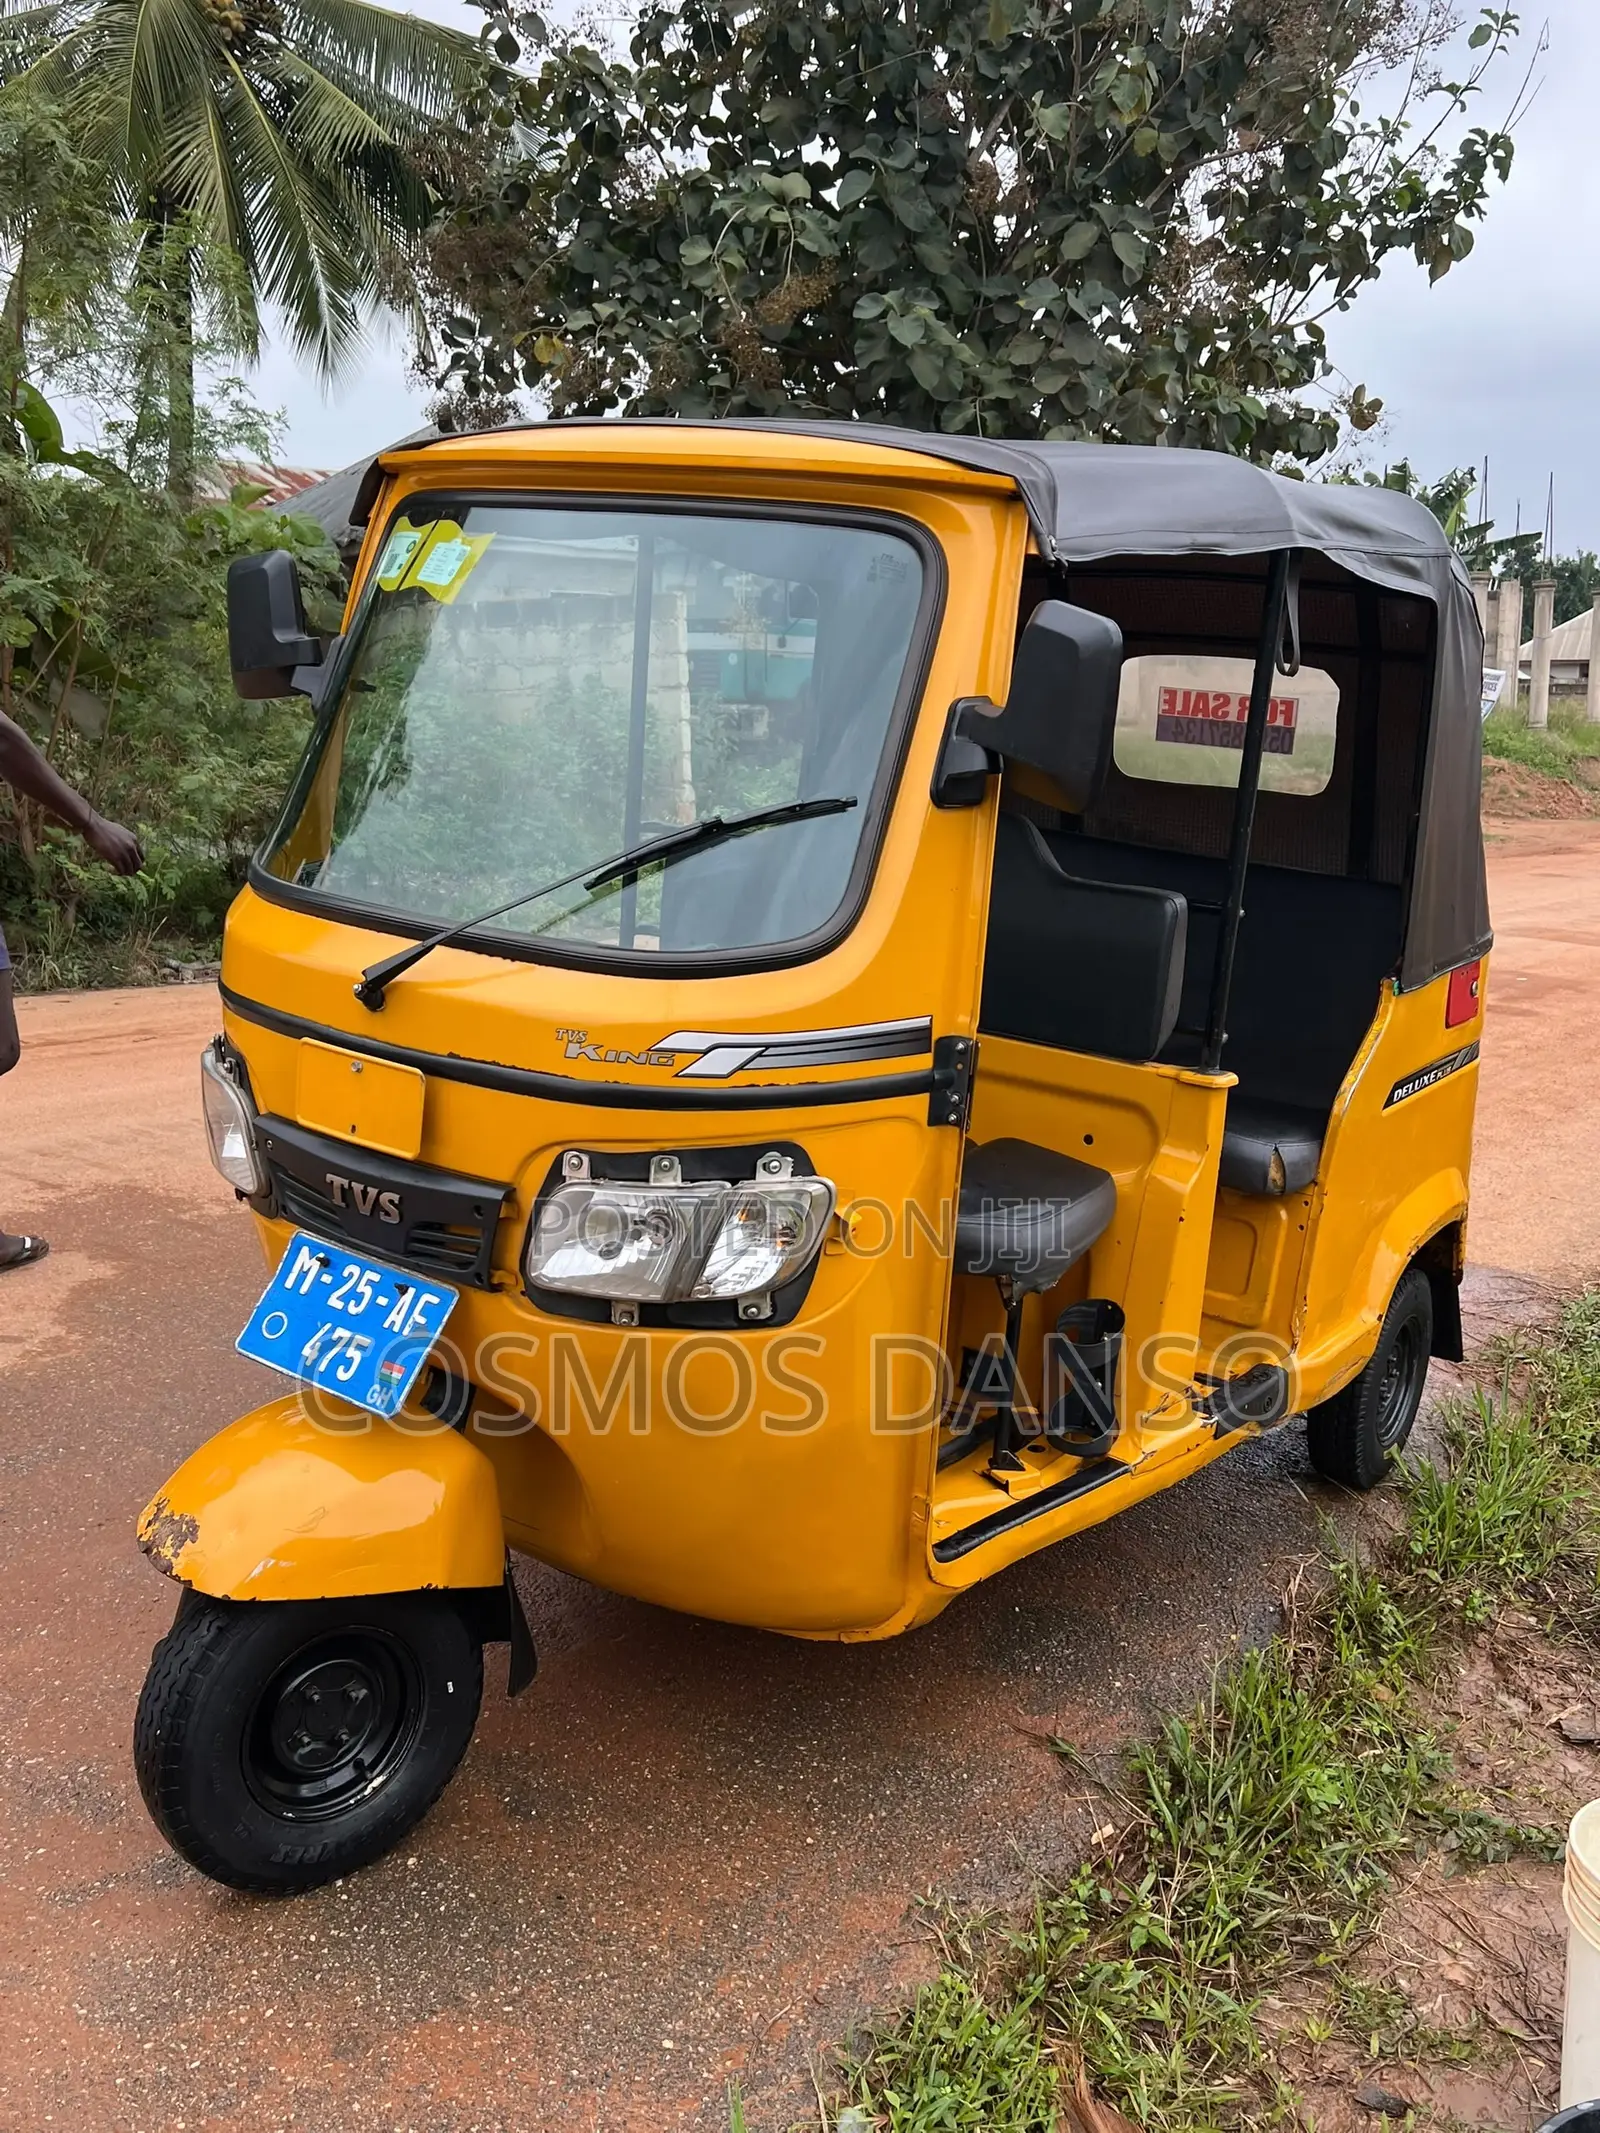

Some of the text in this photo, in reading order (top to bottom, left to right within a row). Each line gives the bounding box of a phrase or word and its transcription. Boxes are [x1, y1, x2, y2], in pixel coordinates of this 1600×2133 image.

[556, 1028, 588, 1043] TVS
[1393, 1069, 1438, 1102] DELUXE
[325, 1173, 401, 1225] TVS
[284, 1245, 441, 1337] M-25-AF
[301, 1322, 373, 1383] 475
[366, 1384, 394, 1410] GH
